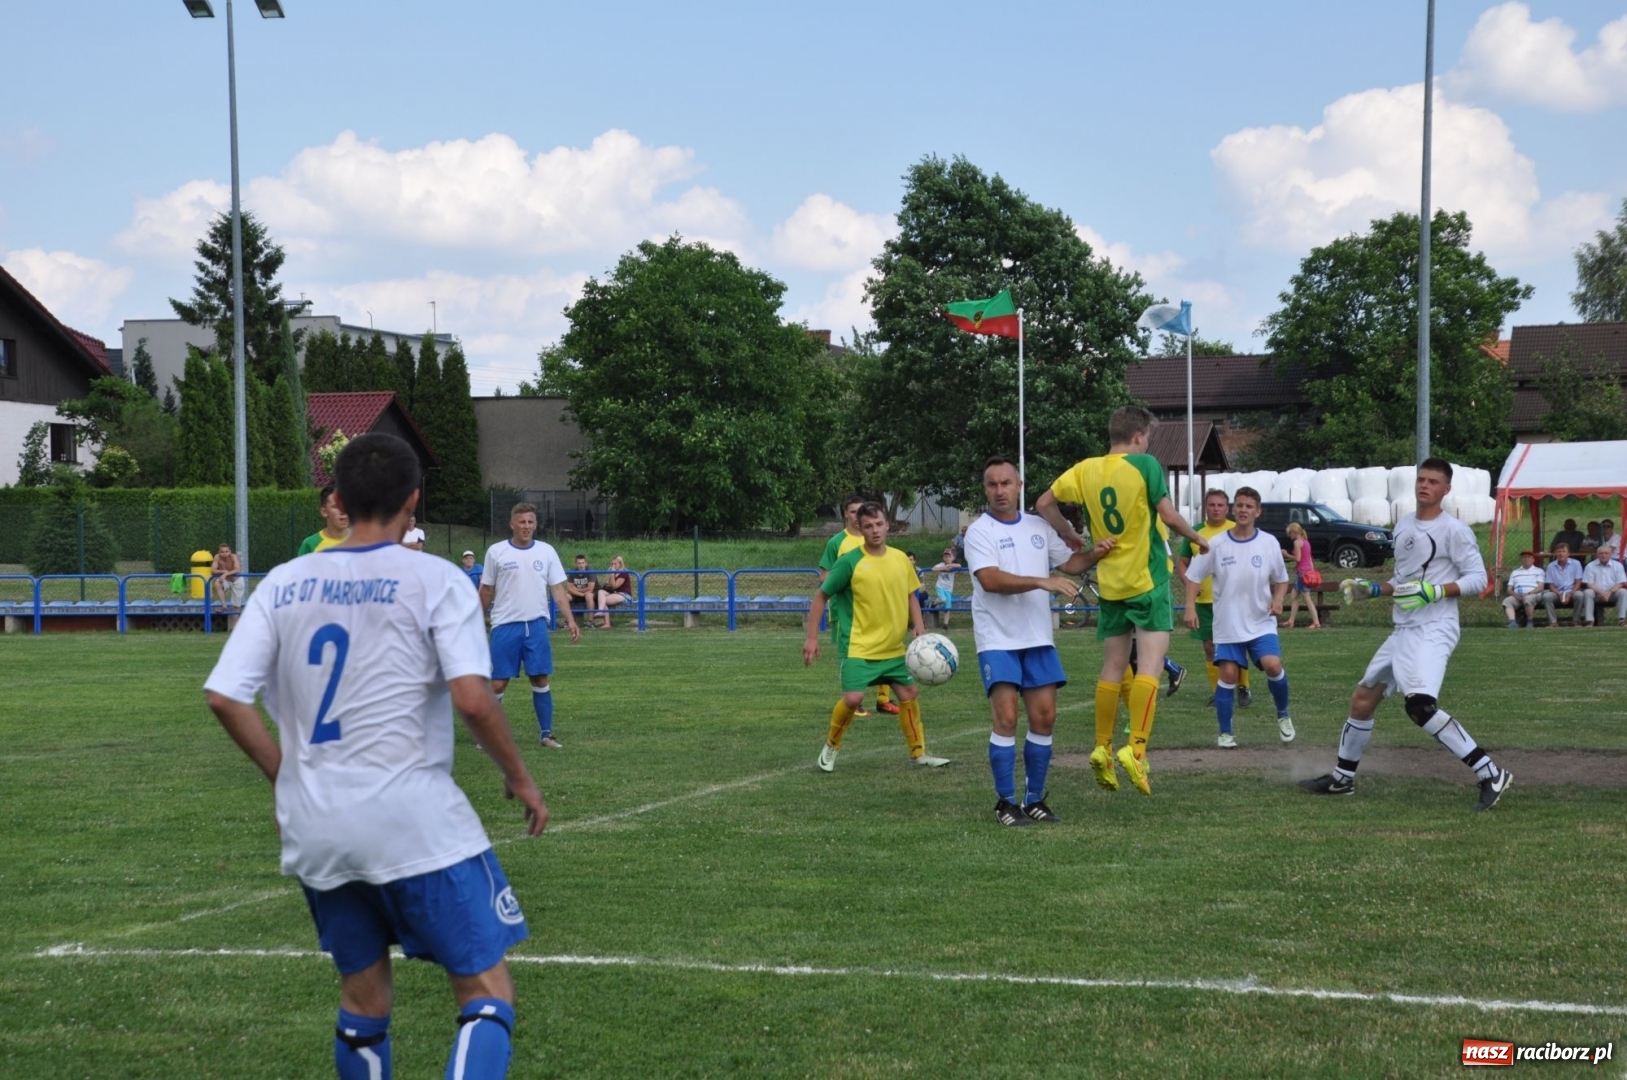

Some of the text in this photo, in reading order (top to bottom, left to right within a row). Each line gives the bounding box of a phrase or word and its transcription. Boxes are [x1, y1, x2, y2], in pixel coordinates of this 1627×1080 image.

[1100, 486, 1125, 536] 8
[300, 577, 317, 602] 07
[308, 622, 350, 745] 2
